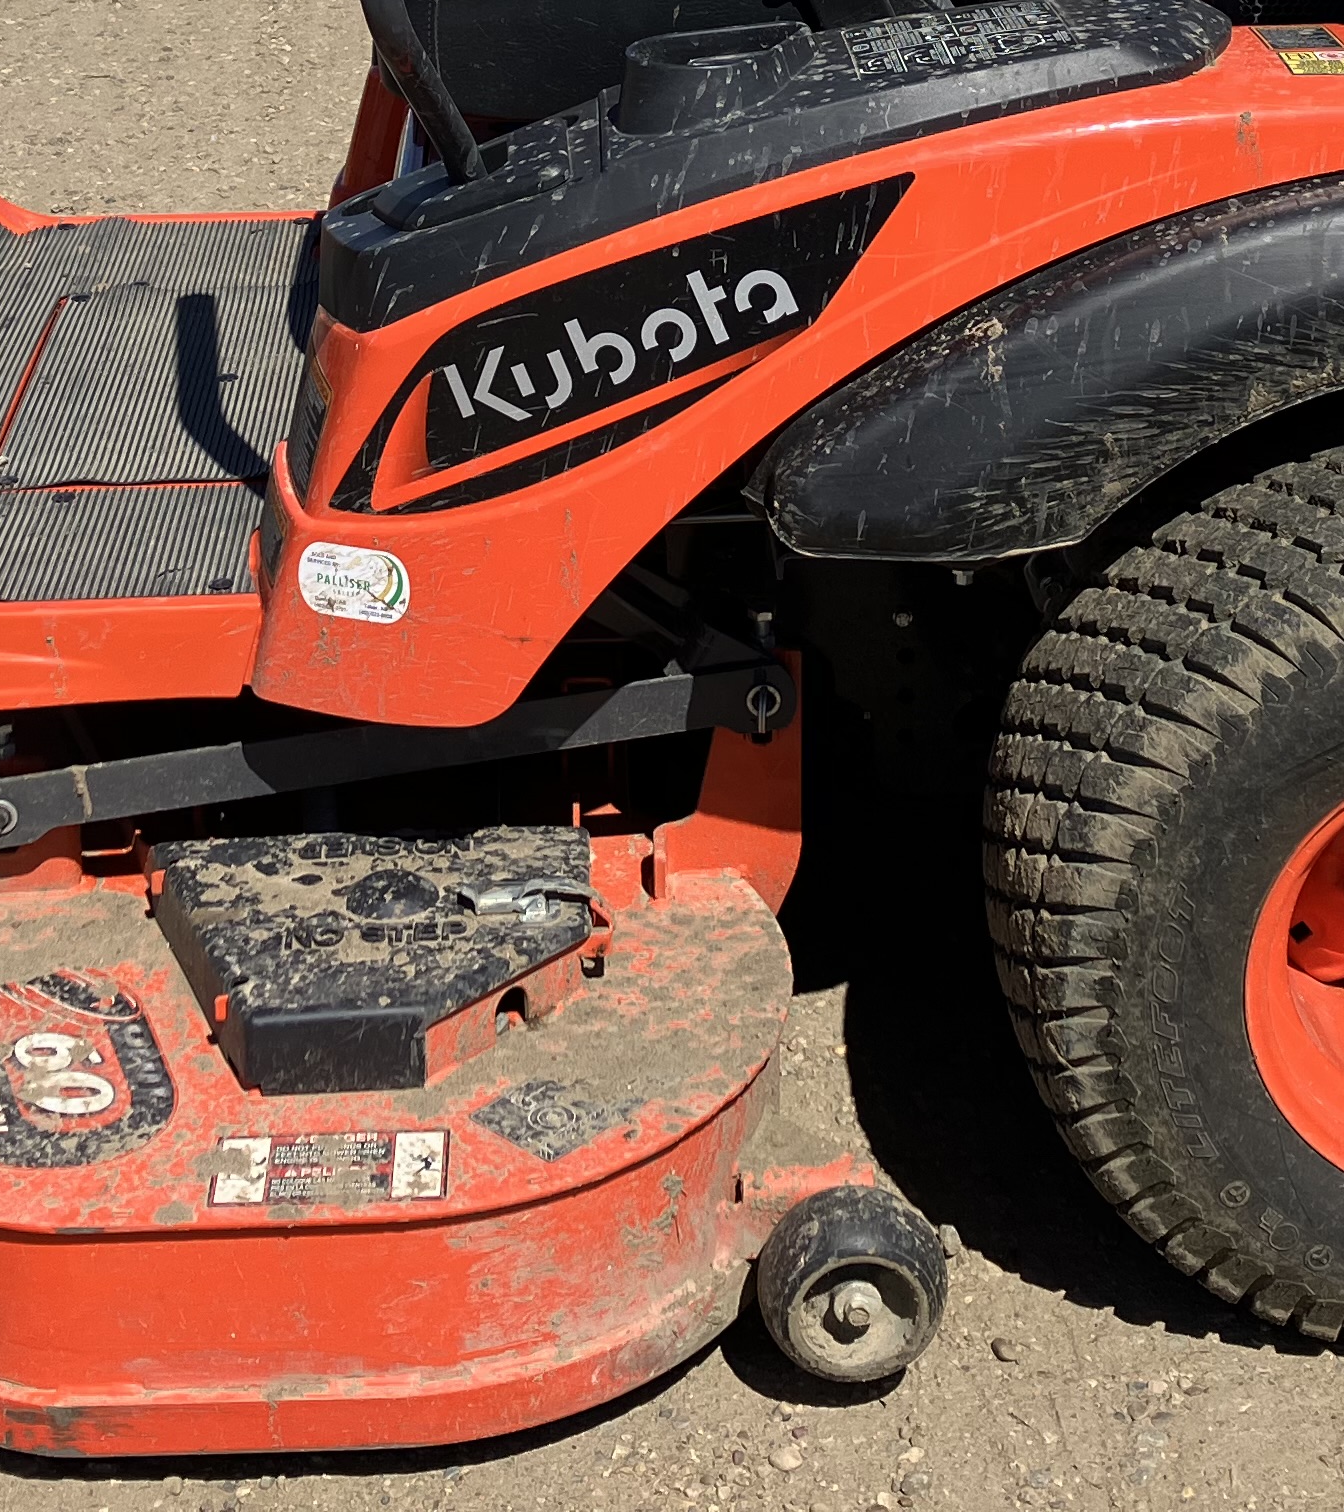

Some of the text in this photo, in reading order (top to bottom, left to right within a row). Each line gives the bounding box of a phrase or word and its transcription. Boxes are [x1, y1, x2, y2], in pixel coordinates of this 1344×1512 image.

[443, 268, 800, 422] Kubota
[316, 572, 371, 591] PALLISER
[360, 920, 468, 946] STEP
[1150, 881, 1220, 1158] LITEFOOT
[14, 1032, 115, 1114] 60
